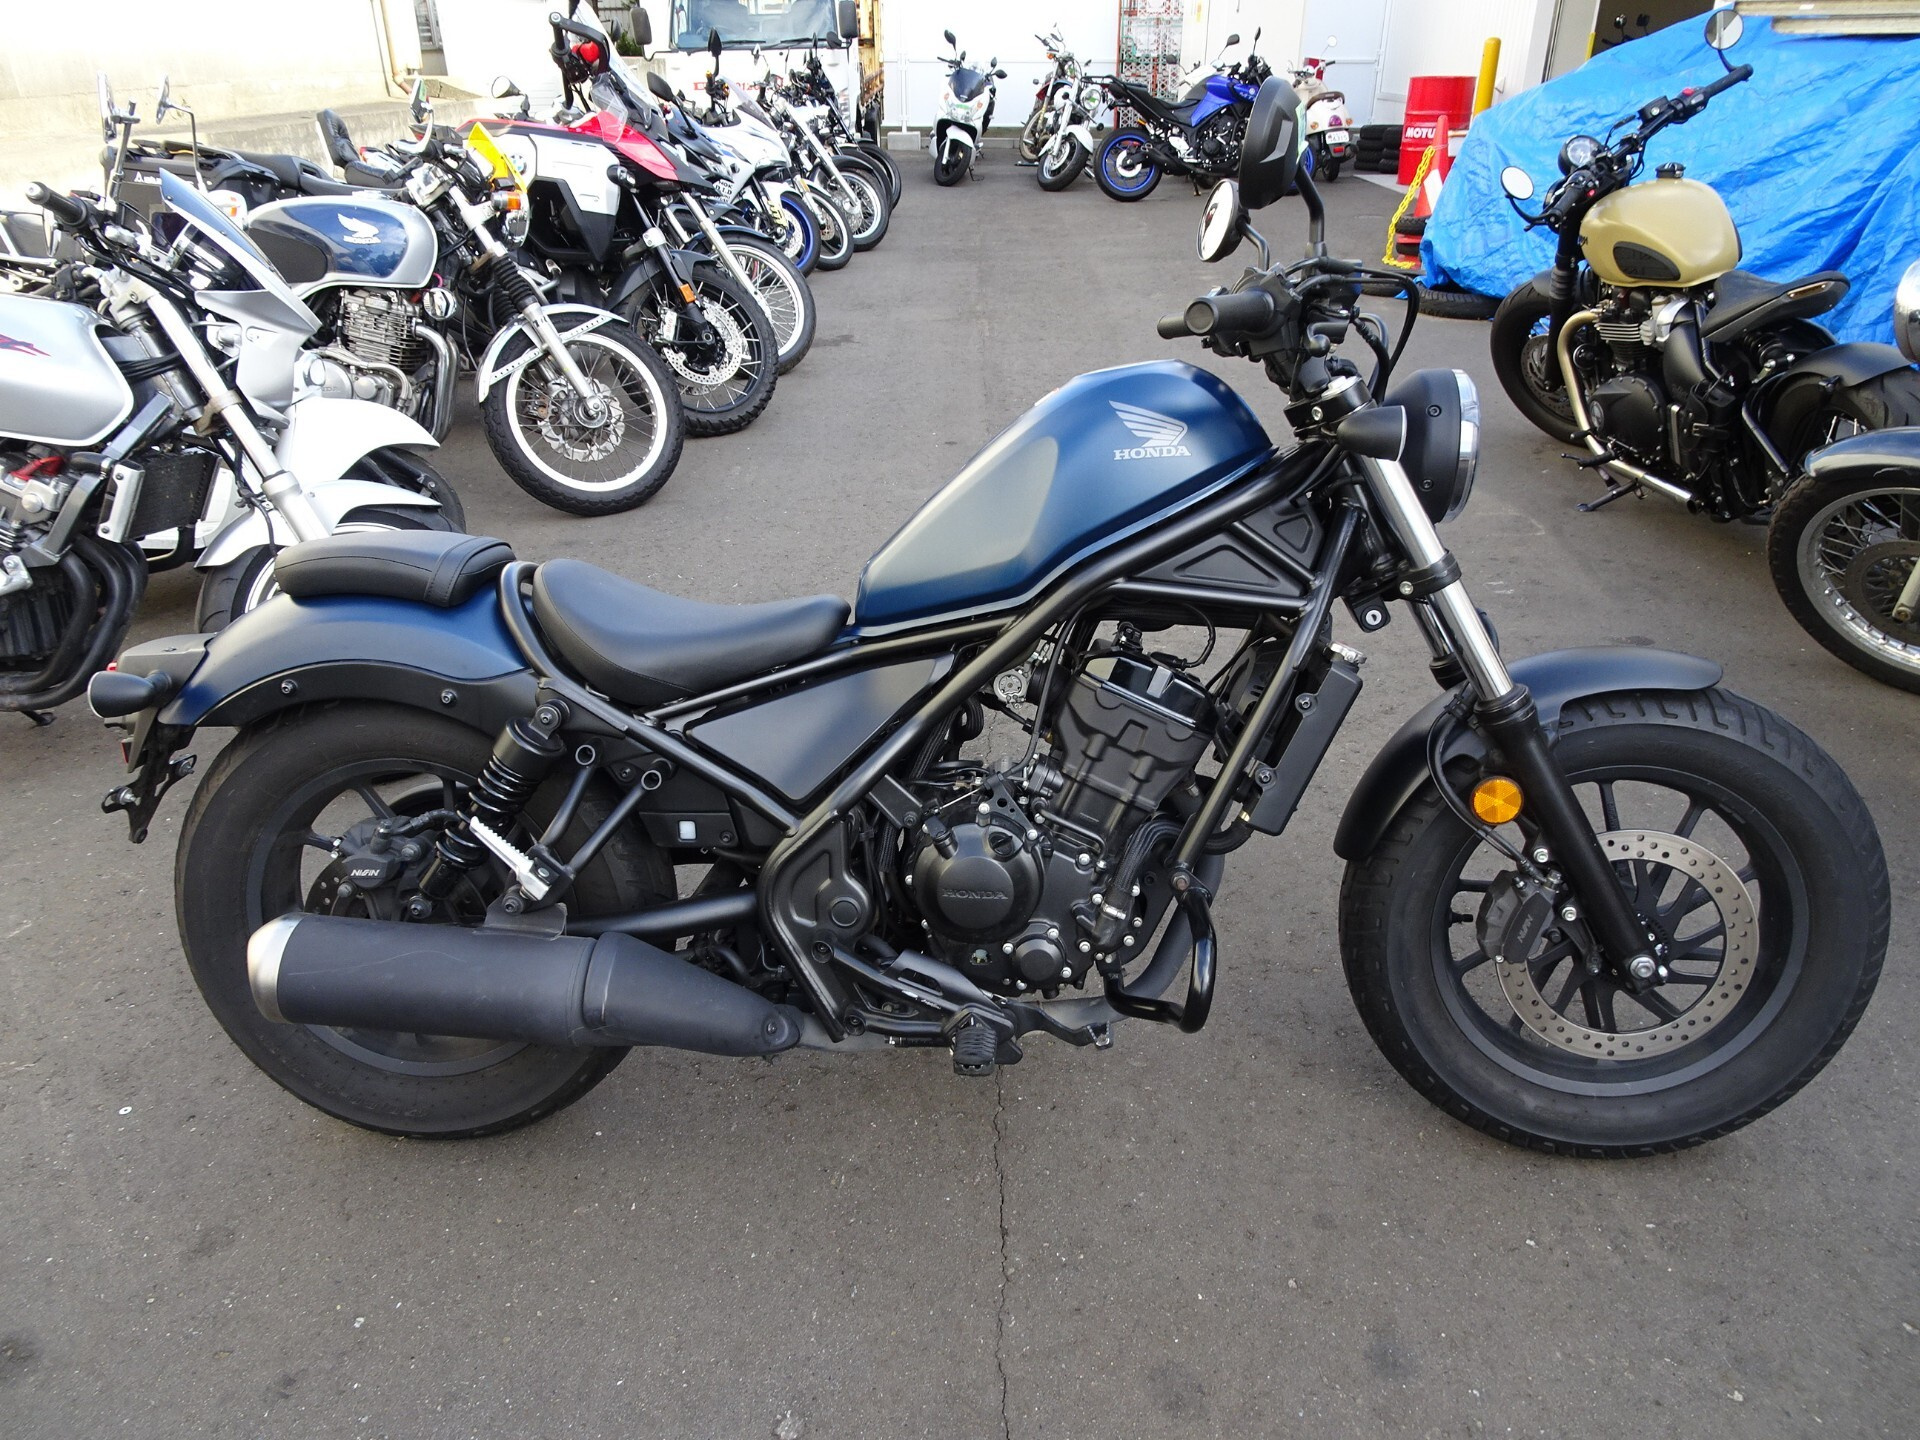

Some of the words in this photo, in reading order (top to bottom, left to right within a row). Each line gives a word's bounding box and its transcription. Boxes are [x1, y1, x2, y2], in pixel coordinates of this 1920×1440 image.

[1405, 127, 1436, 139] MOTU
[1113, 445, 1192, 461] HONDA
[942, 888, 1009, 900] HONDA
